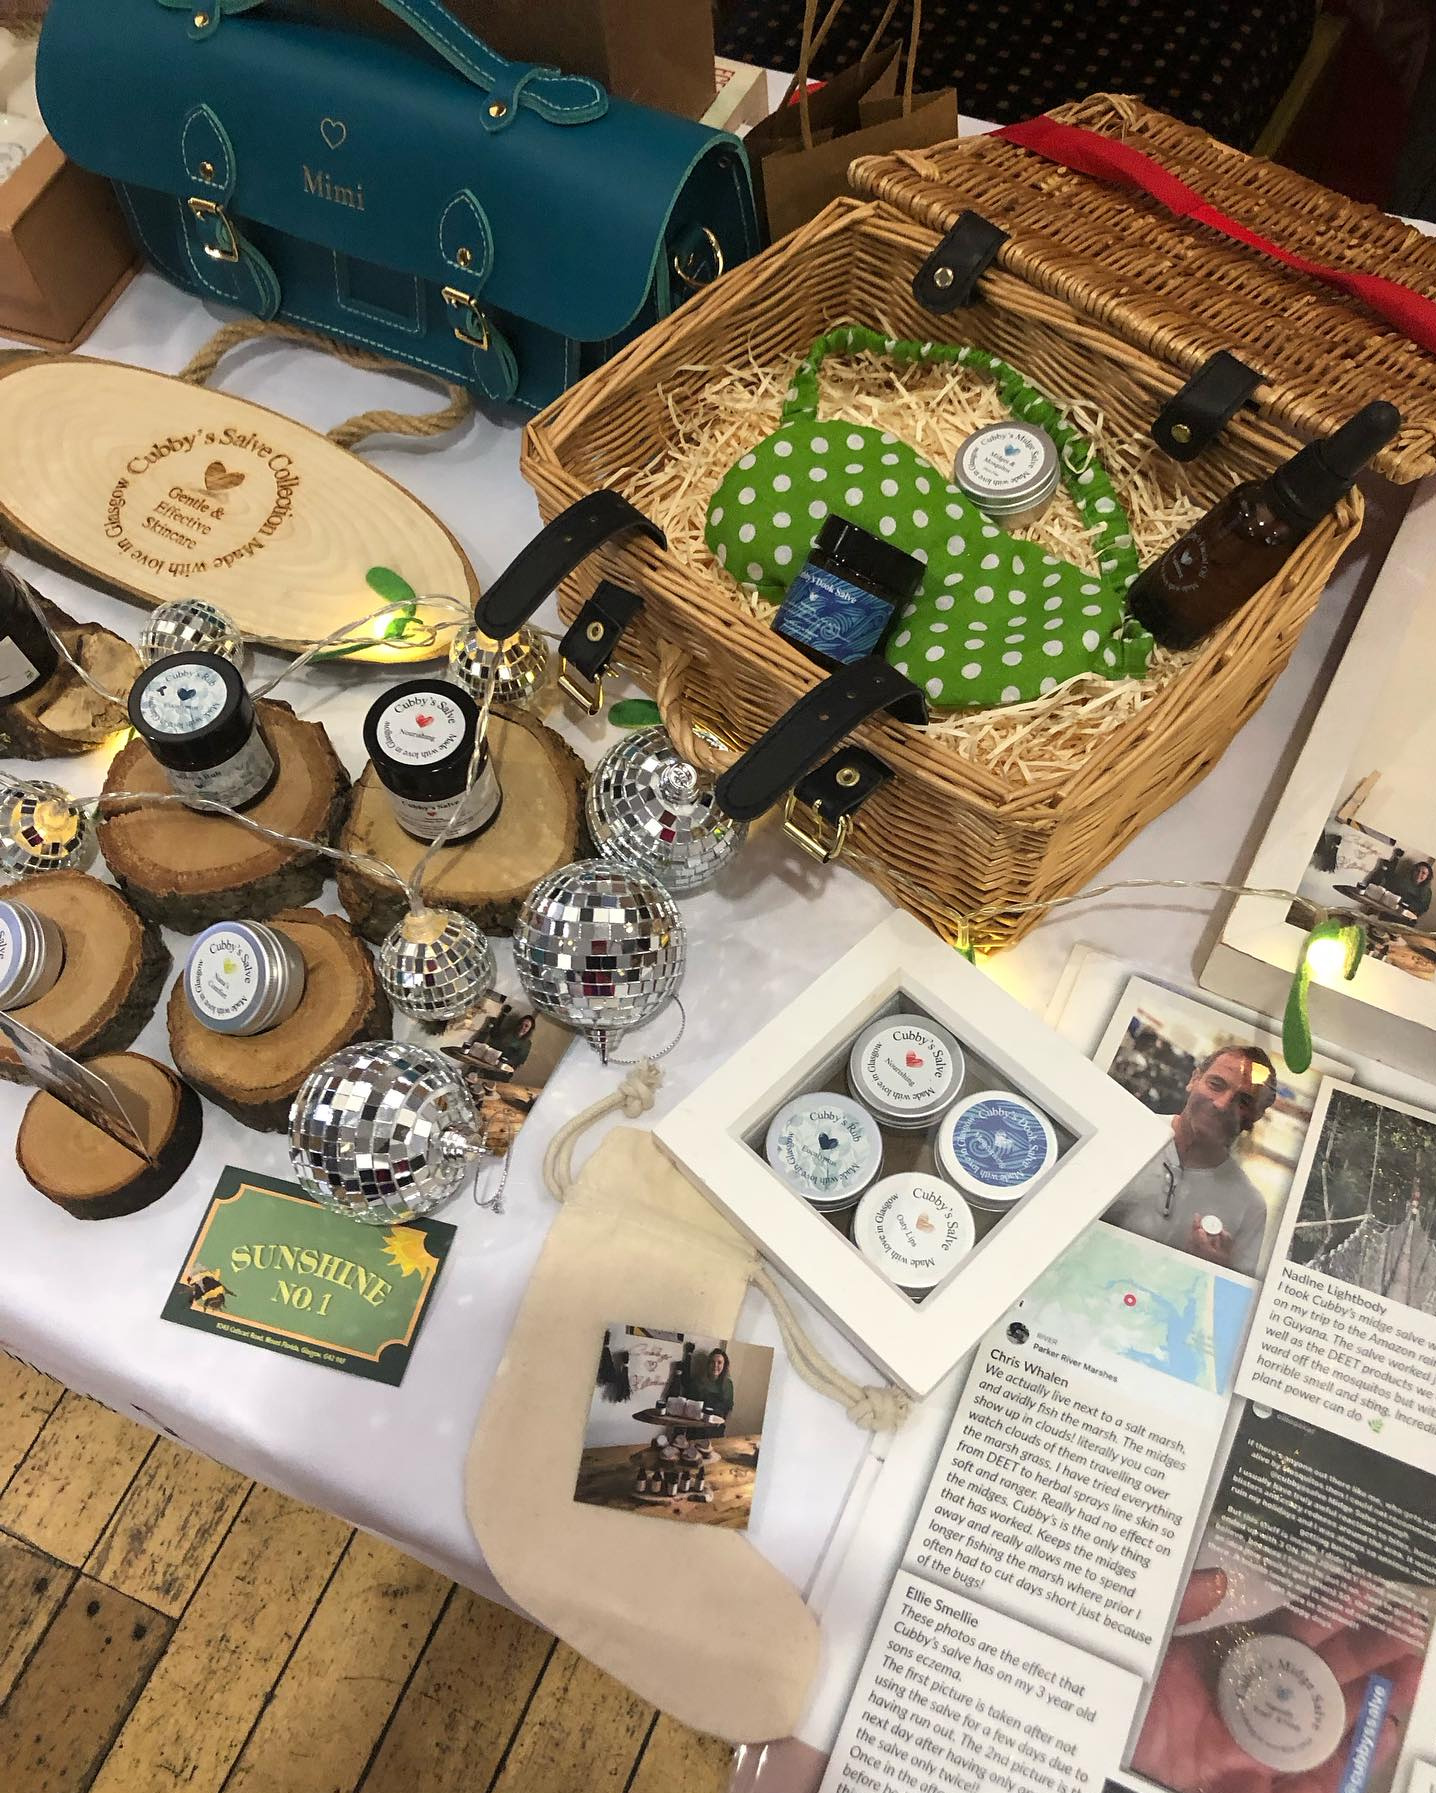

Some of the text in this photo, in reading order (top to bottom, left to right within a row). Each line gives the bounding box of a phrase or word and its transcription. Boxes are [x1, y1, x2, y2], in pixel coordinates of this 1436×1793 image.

[303, 164, 364, 210] Mimi
[127, 428, 299, 536] Cubby's Salve Collection
[152, 501, 211, 535] Effective
[168, 487, 224, 520] Gentle &
[104, 478, 264, 577] Made with love in Glasgow
[142, 516, 197, 549] Skincare
[835, 587, 857, 604] Salve
[394, 697, 456, 724] Cubby's Salve
[210, 940, 242, 956] Cubby's
[241, 954, 253, 984] Salve
[868, 1042, 882, 1072] Glasgow
[885, 1058, 915, 1087] Nourishing
[893, 1031, 946, 1078] Cubby's Salve
[872, 1074, 879, 1082] in
[877, 1082, 892, 1096] love
[913, 1088, 935, 1100] Made
[810, 1111, 861, 1142] Cubby's Rub
[978, 1108, 1017, 1120] Cubby's
[1019, 1119, 1038, 1142] Dook
[1023, 1144, 1038, 1168] Salve
[875, 1194, 935, 1268] Made with love in Glasgow
[897, 1214, 917, 1247] Oaty Lips
[913, 1188, 958, 1251] Cubby's Salve
[231, 1244, 393, 1307] SUNSHINE
[1282, 1266, 1386, 1315] Nadine Lightbody
[1273, 1298, 1416, 1358] on my trip to the Amazon
[1276, 1280, 1425, 1346] I took Cubby's midge salve
[1032, 1342, 1118, 1383] Parker River Marshes
[1268, 1309, 1280, 1322] in
[1333, 1333, 1353, 1350] The
[1355, 1346, 1385, 1363] salve
[1388, 1358, 1430, 1380] worked
[990, 1348, 1068, 1387] Chris Whalen
[985, 1362, 1184, 1454] We actually live next to a salt marsh,
[1251, 1371, 1362, 1421] plant power can do
[973, 1395, 1165, 1480] show up in clouds! literally you can
[978, 1380, 1185, 1470] and avidly fish the marsh. The midges
[915, 1554, 985, 1589] of the bugs!
[922, 1538, 1152, 1645] often had to cut days short just because
[905, 1586, 978, 1627] Ellie Smellie
[901, 1602, 1085, 1696] These photos are the effect that
[893, 1621, 1096, 1722] Cubby's salve has on my 3 year old
